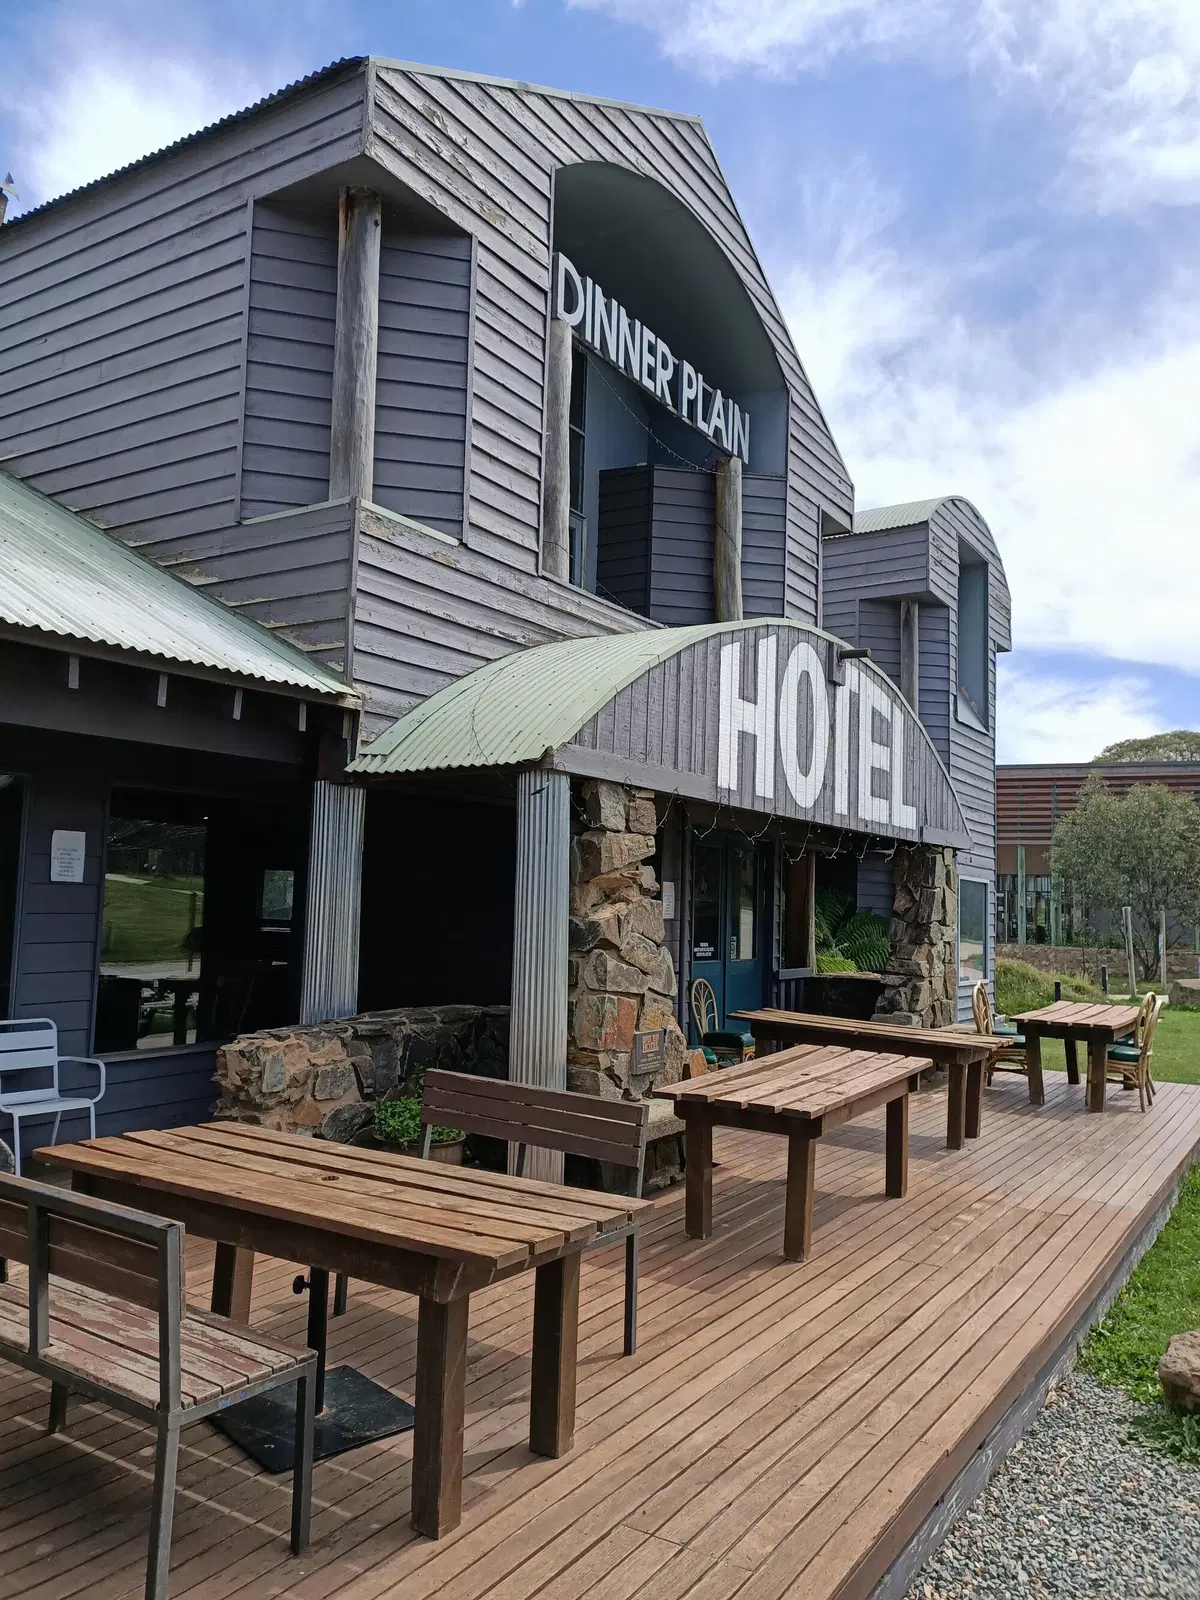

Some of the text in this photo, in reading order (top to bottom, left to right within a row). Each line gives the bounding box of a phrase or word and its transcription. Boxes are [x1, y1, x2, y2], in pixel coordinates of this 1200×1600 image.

[554, 252, 750, 464] DINNER PLAIN
[718, 634, 916, 830] HOTEL
